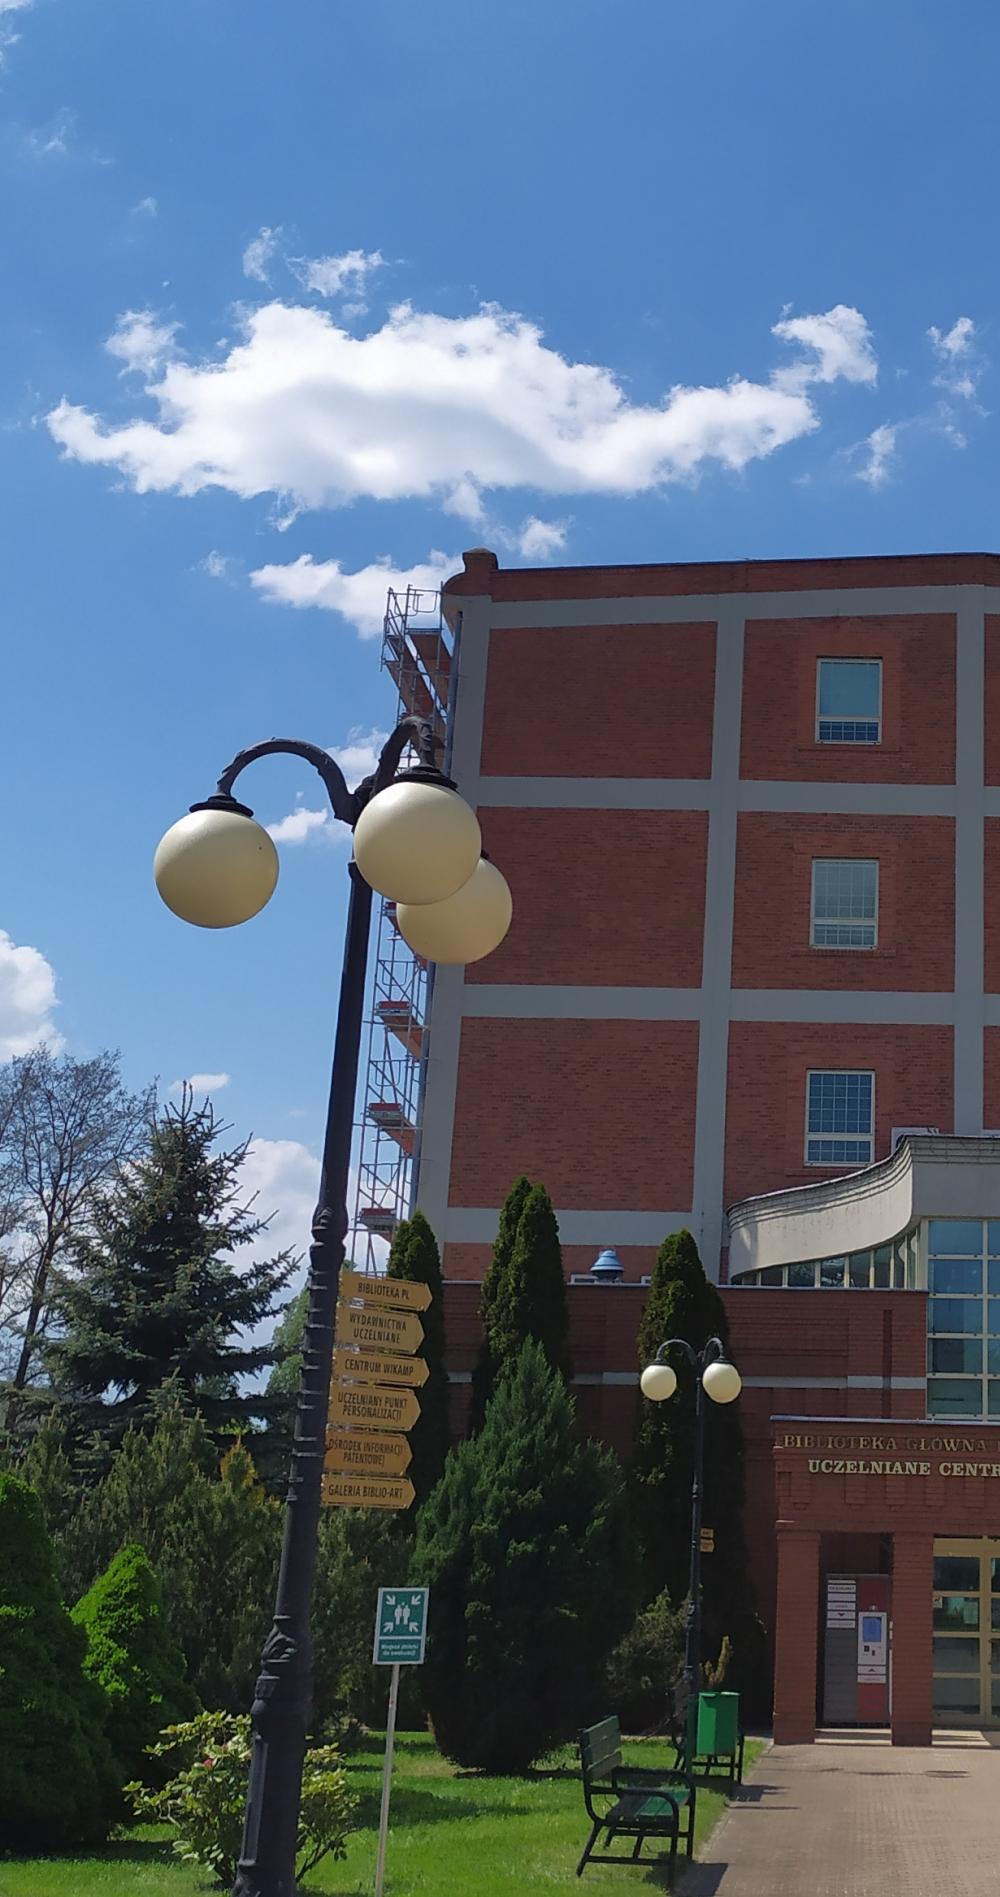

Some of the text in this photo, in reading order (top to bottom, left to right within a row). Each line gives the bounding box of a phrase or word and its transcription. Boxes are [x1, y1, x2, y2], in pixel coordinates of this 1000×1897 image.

[358, 1282, 409, 1300] BIBLIOTEKA PL
[349, 1312, 407, 1331] WYDAWNICTWA
[353, 1328, 400, 1344] UCZELNIANE
[345, 1359, 414, 1377] CENTRUM WIKAMP
[338, 1392, 408, 1408] UCZELNIANY PUNKT
[342, 1404, 402, 1422] PERSONALIZACJI
[784, 1435, 898, 1450] BIBLIOTEKA
[906, 1436, 987, 1452] GŁÓWNA
[343, 1452, 385, 1467] PATENTOWEJ
[808, 1459, 931, 1475] UCZELNIANE
[328, 1484, 403, 1499] GALERIA BIBLIO-ART
